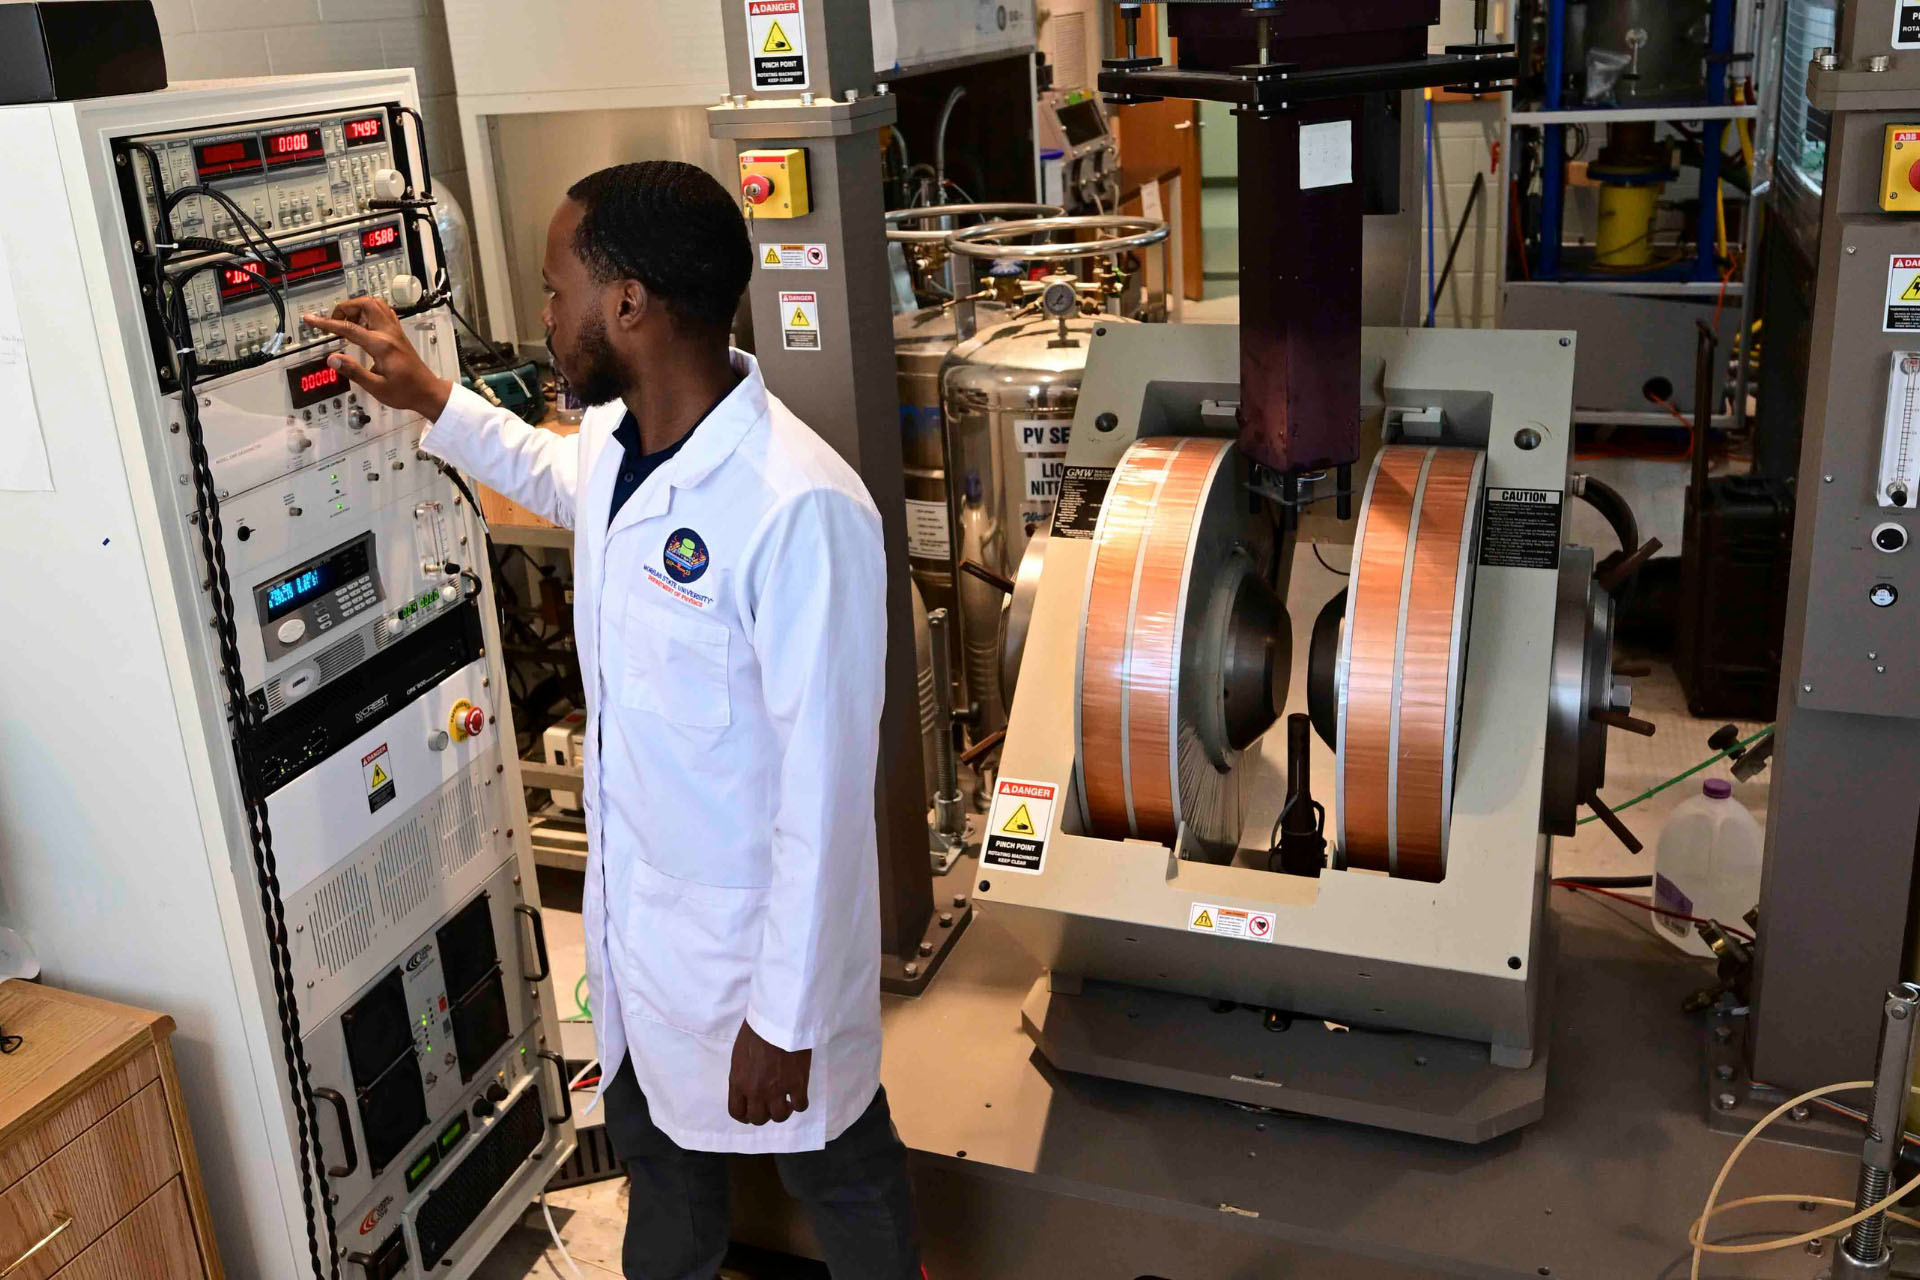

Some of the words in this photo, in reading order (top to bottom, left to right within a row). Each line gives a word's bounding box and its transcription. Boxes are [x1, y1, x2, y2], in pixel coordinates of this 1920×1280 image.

[760, 2, 796, 13] DANGER
[1899, 133, 1917, 141] ABB
[1023, 427, 1044, 444] PV
[1066, 468, 1094, 477] GMW
[1502, 490, 1547, 503] CAUTION
[643, 564, 662, 579] MORGAN
[662, 574, 677, 589] STATE
[1011, 785, 1051, 797] DANGER
[995, 840, 1016, 849] PINCH
[1016, 843, 1036, 852] POINT
[987, 850, 1011, 858] ROTATING
[1011, 853, 1040, 861] MACHINERY
